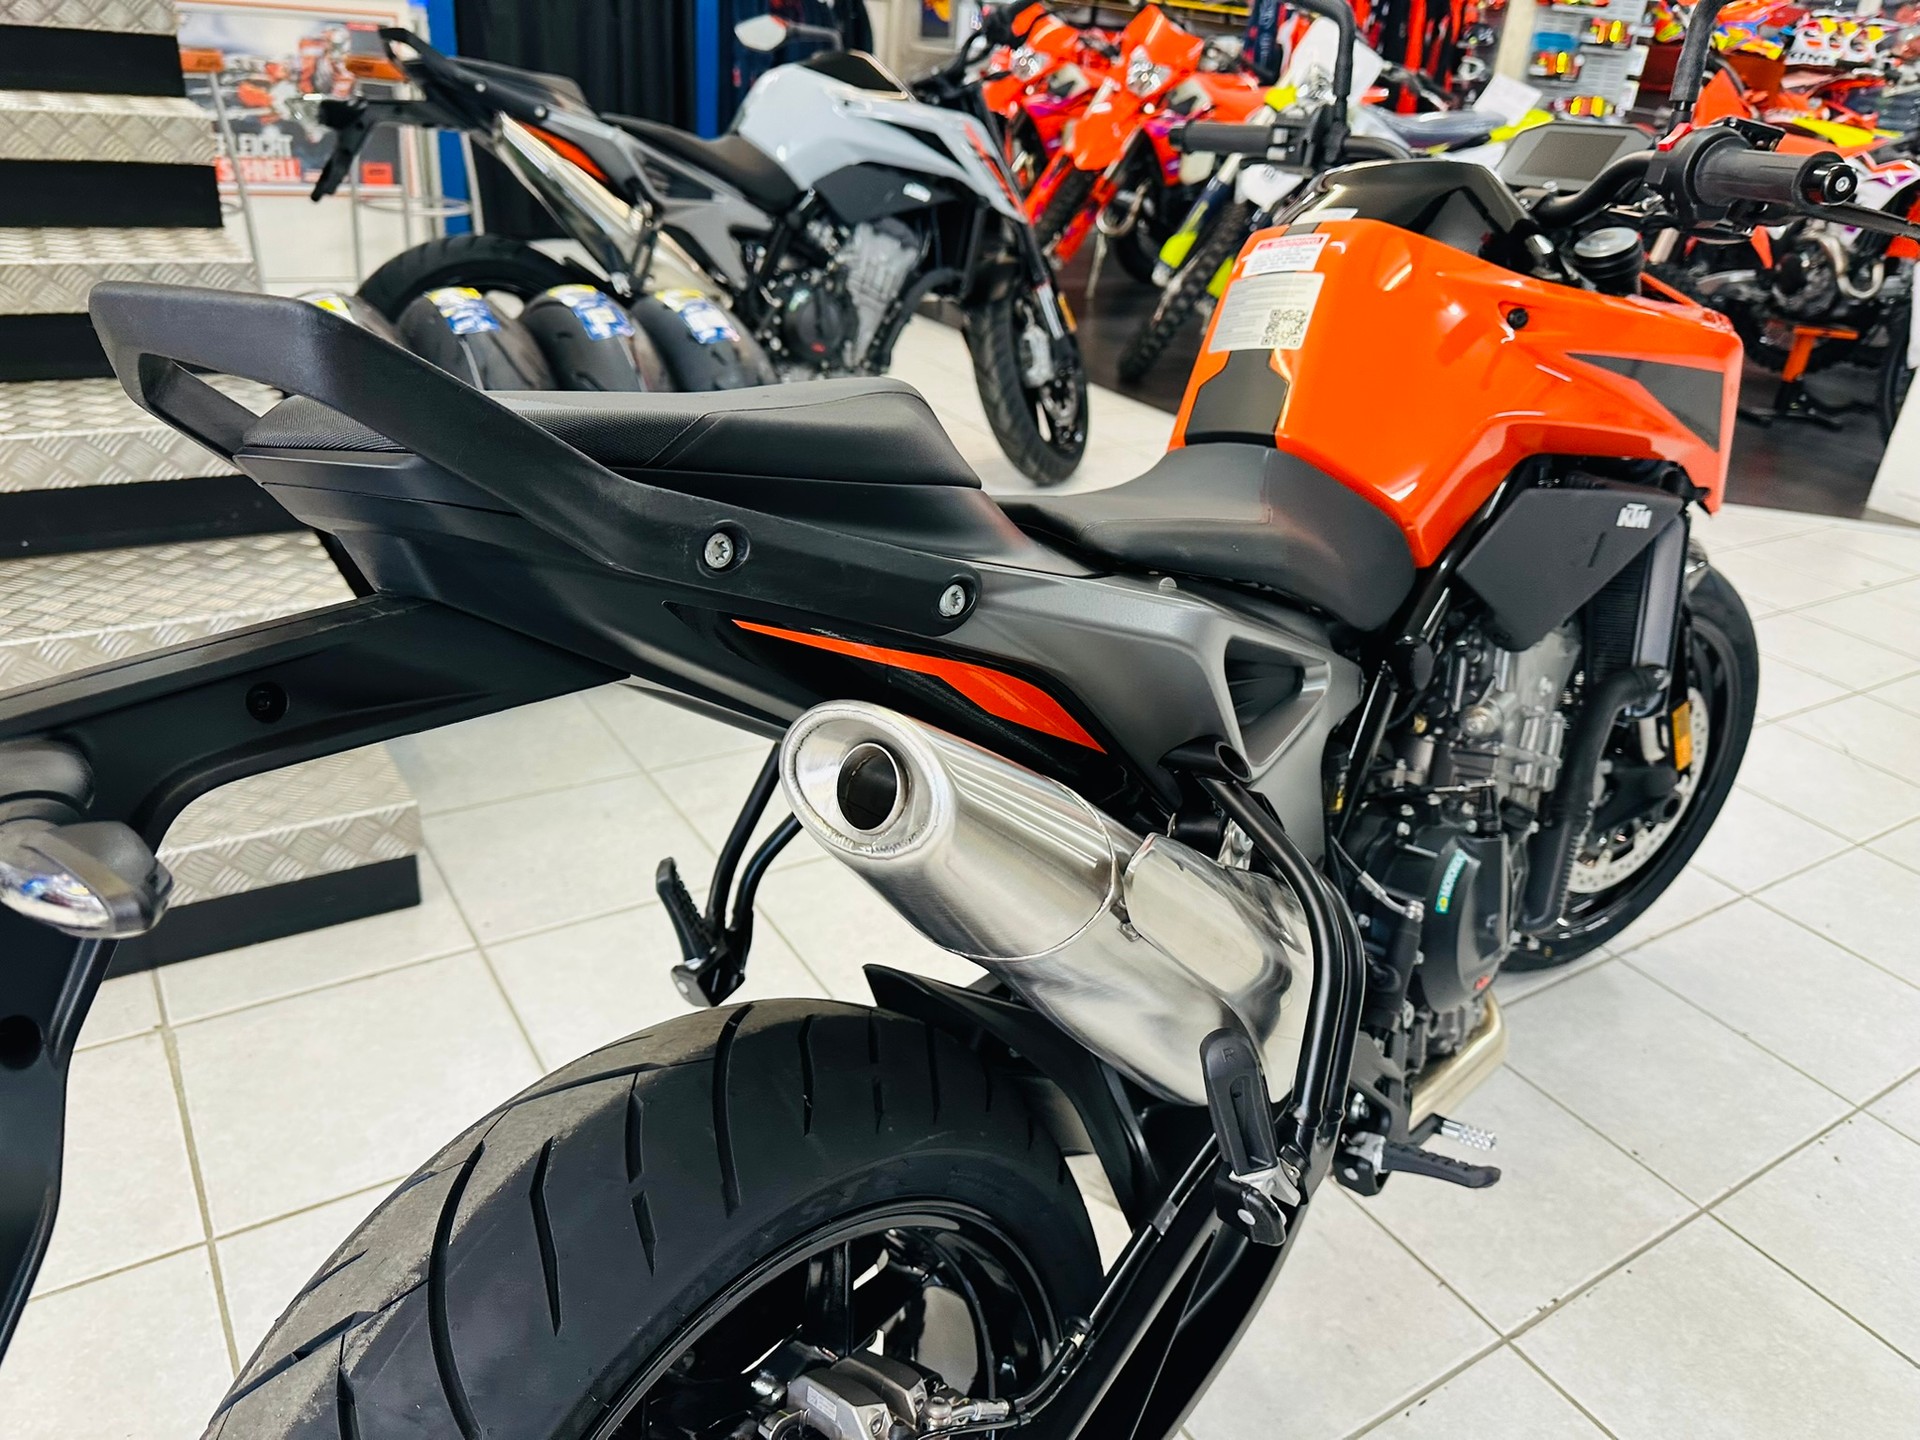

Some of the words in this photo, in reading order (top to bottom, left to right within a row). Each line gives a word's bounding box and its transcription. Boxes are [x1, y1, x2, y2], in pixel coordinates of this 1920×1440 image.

[233, 133, 293, 157] EICHT
[218, 157, 300, 182] SHNELL
[1616, 503, 1652, 529] KTM
